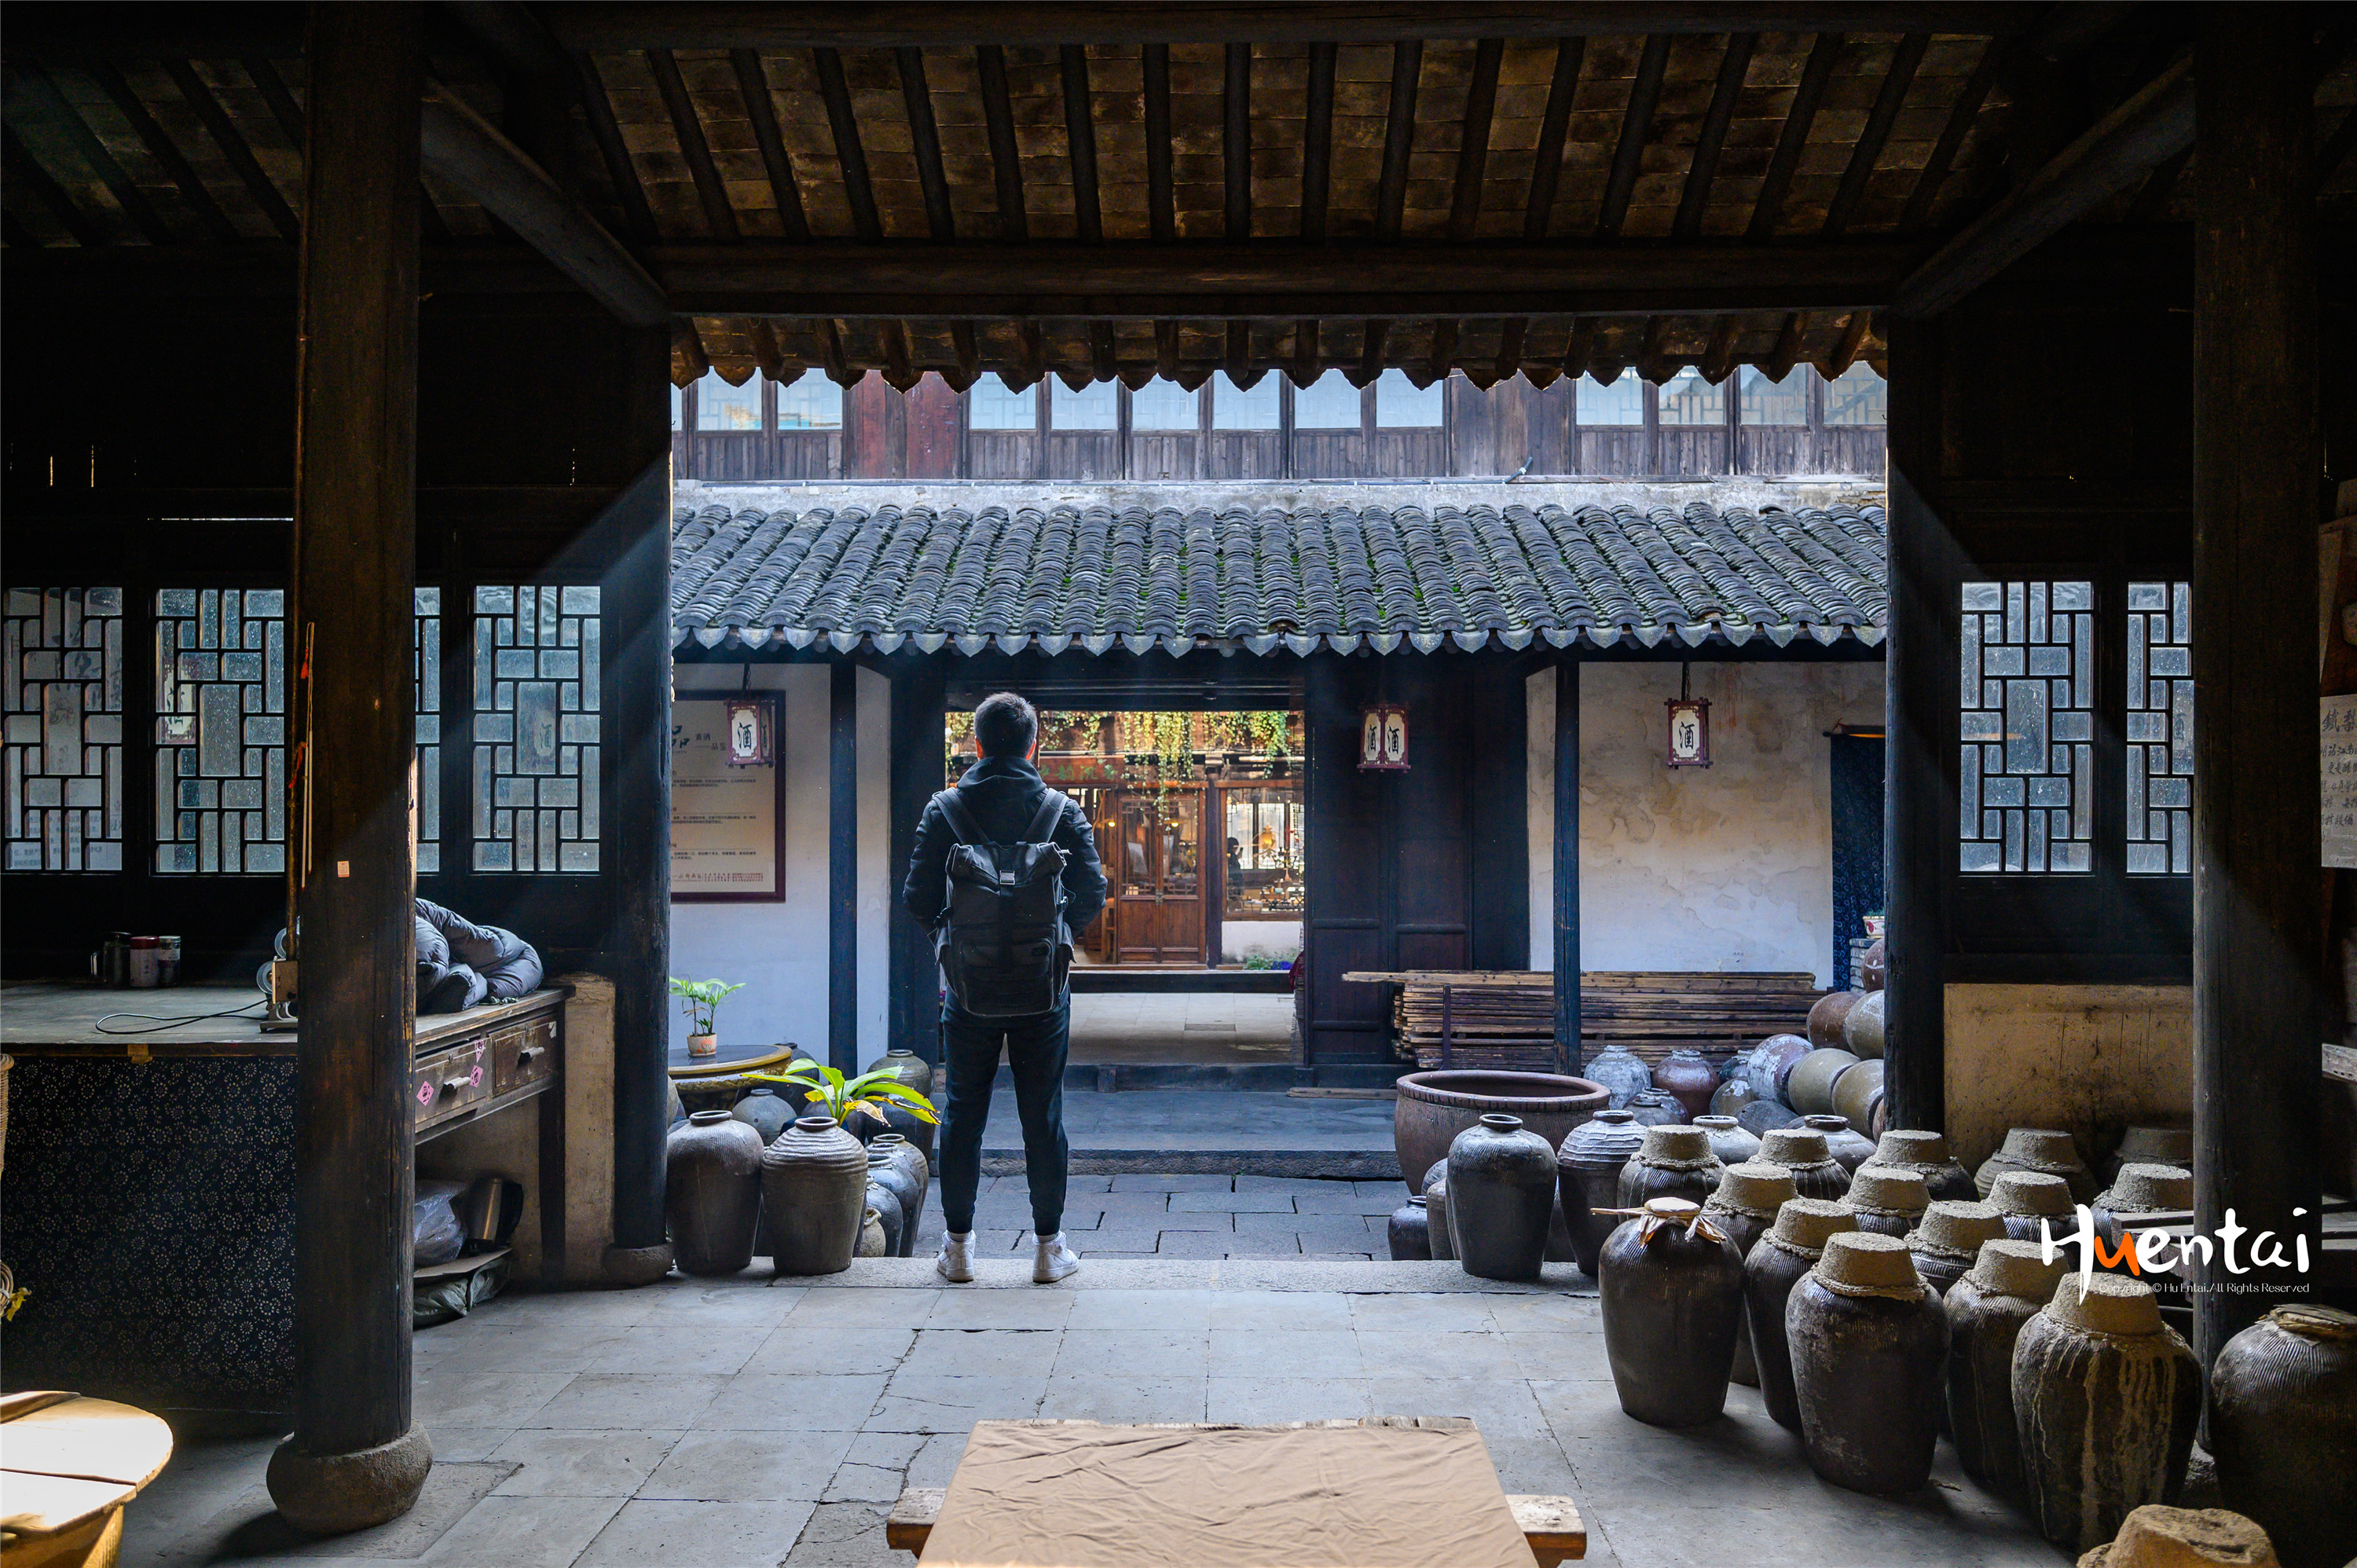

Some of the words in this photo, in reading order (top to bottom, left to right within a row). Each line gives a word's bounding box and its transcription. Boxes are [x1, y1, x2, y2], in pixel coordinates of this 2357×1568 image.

[2322, 707, 2357, 733] 鐵梨
[738, 722, 753, 749] 酒
[1368, 724, 1377, 753] 酒
[1387, 724, 1400, 755] 酒
[1678, 721, 1695, 750] 酒
